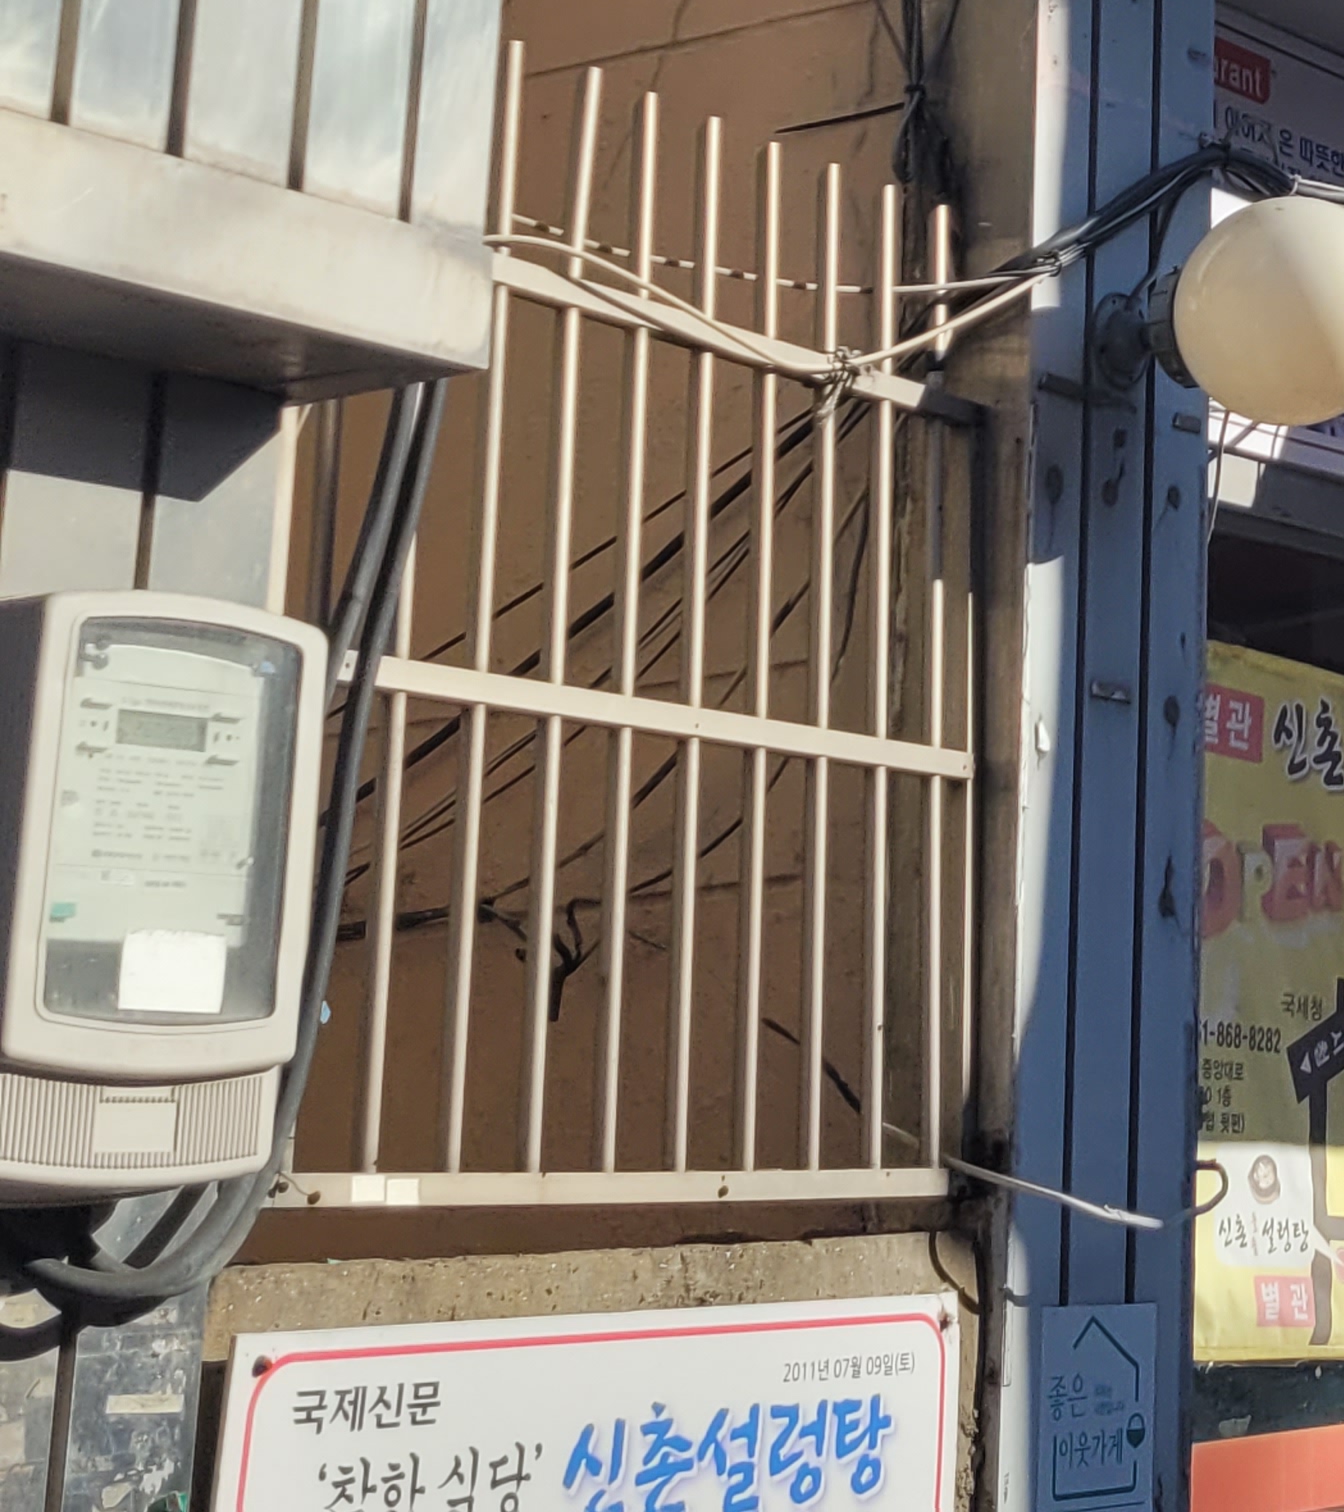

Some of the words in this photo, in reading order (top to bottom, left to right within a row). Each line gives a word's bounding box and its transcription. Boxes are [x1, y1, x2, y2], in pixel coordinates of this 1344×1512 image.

[1214, 57, 1263, 99] rant
[1272, 698, 1344, 789] 신촌
[1202, 819, 1344, 938] OPEN
[1281, 993, 1323, 1021] 국세청
[1201, 1019, 1282, 1054] 1-868-8282
[1261, 1280, 1309, 1321] 별관
[783, 1356, 831, 1383] 2011년
[833, 1355, 863, 1380] 07월
[865, 1351, 916, 1378] 09일(토)
[292, 1381, 442, 1434] 국제신문
[1048, 1373, 1088, 1422] 좋은
[562, 1394, 893, 1511] 신촌설렁탕
[1059, 1427, 1123, 1469] 이웃가게
